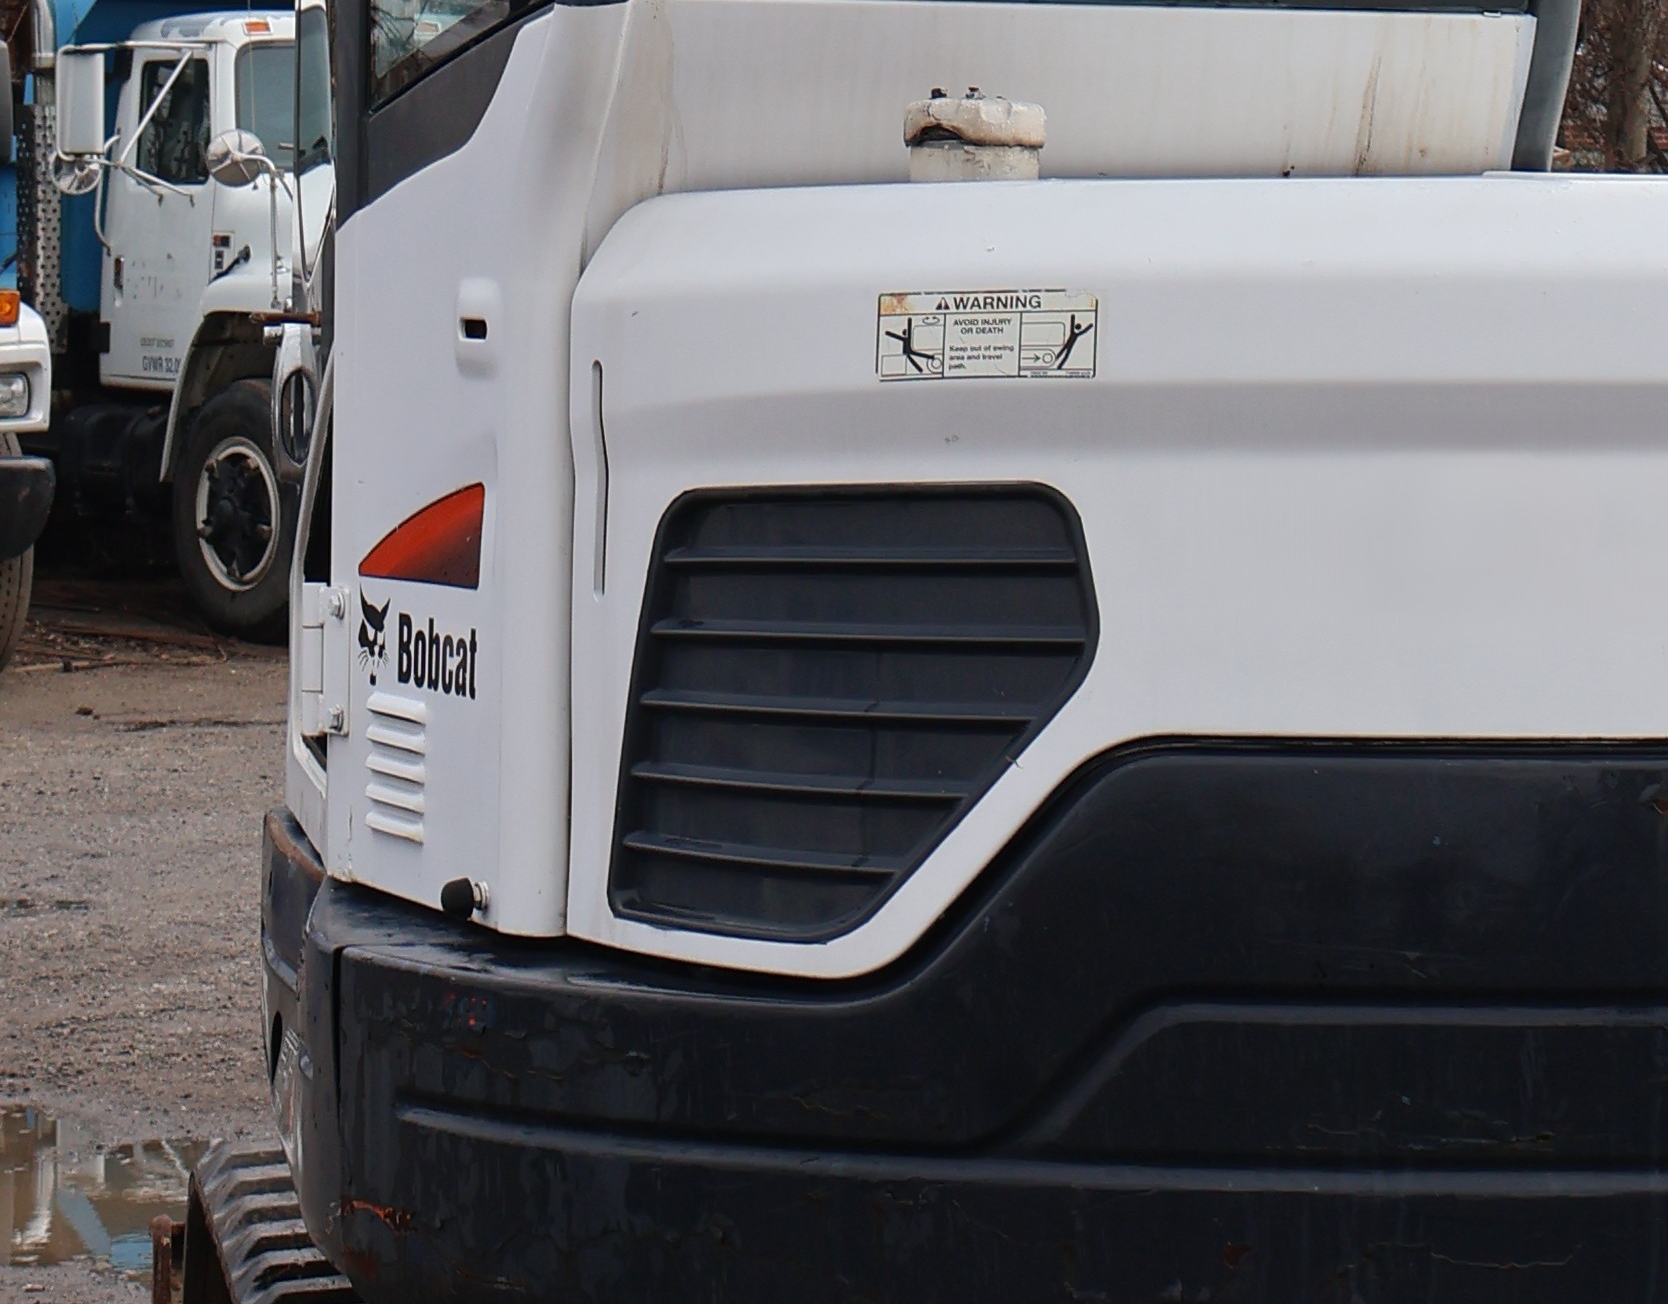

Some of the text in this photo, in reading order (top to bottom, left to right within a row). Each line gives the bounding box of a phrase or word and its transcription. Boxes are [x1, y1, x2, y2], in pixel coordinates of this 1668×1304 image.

[953, 295, 1042, 311] WARNING
[953, 317, 1012, 327] AVOID INJURY
[960, 326, 1004, 335] OR DEATH
[949, 345, 968, 353] Keep
[967, 353, 980, 361] and
[982, 353, 1003, 361] travel
[397, 612, 478, 700] Bobcat
